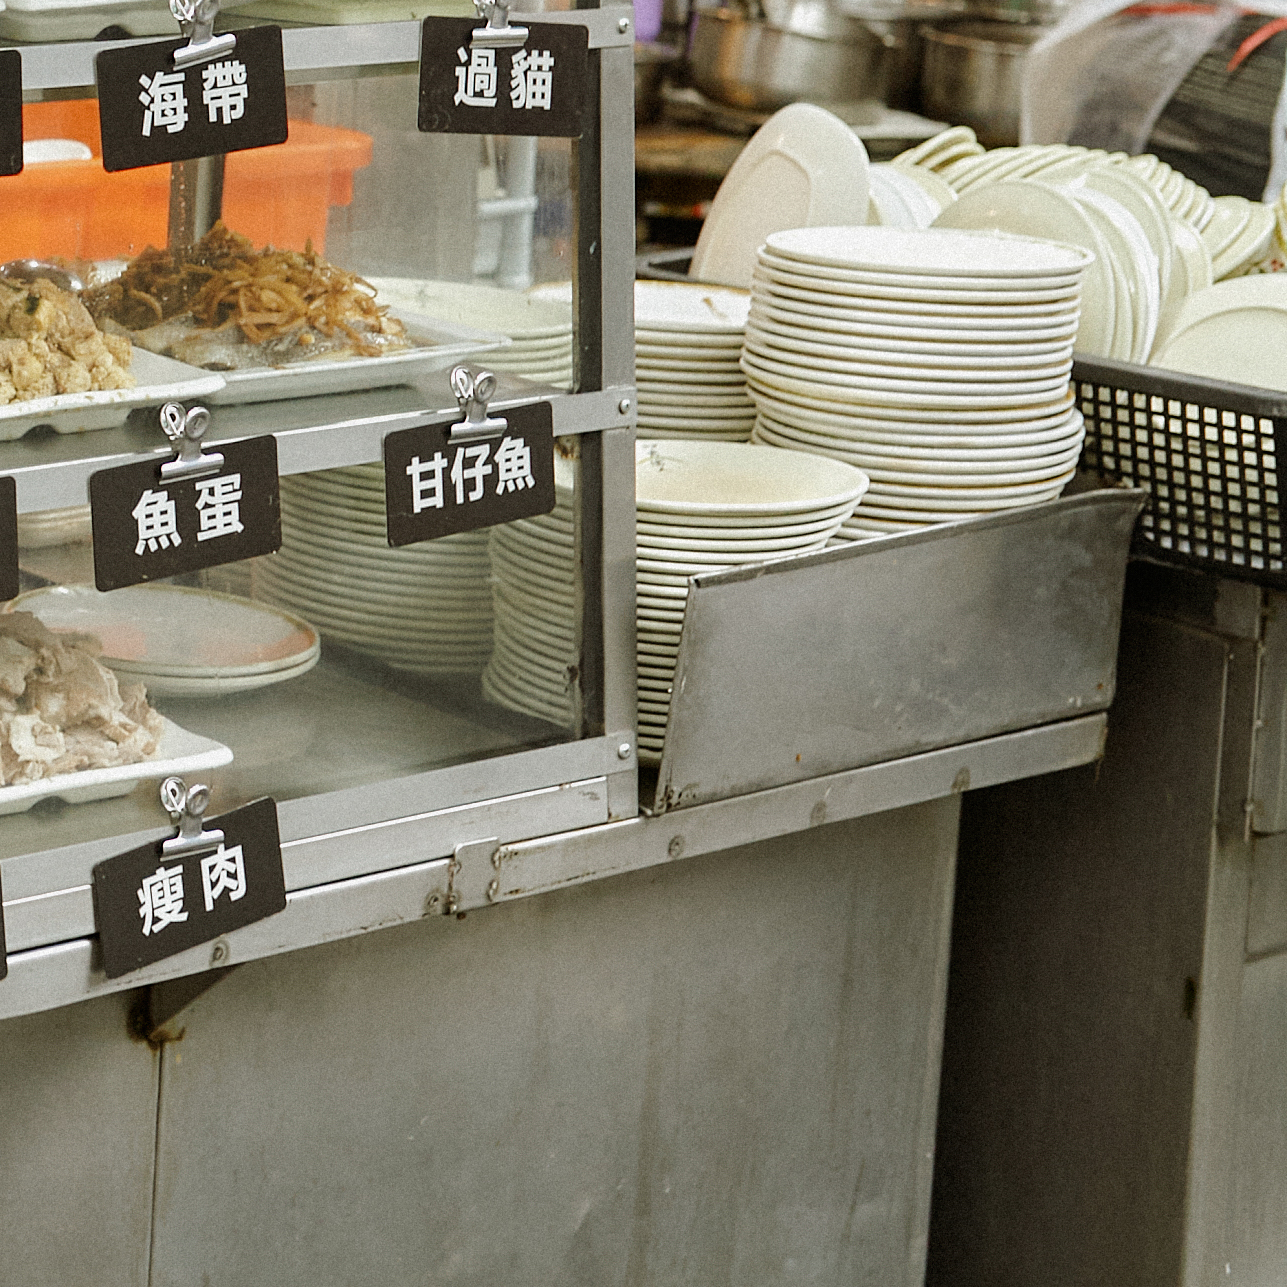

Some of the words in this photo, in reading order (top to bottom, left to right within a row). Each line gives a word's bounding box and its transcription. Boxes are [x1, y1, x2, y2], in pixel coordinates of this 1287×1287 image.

[138, 60, 248, 138] 海帶
[454, 46, 555, 111] 過貓
[132, 473, 245, 555] 魚蛋
[407, 437, 535, 513] 甘仔魚
[137, 844, 246, 936] 瘦肉
